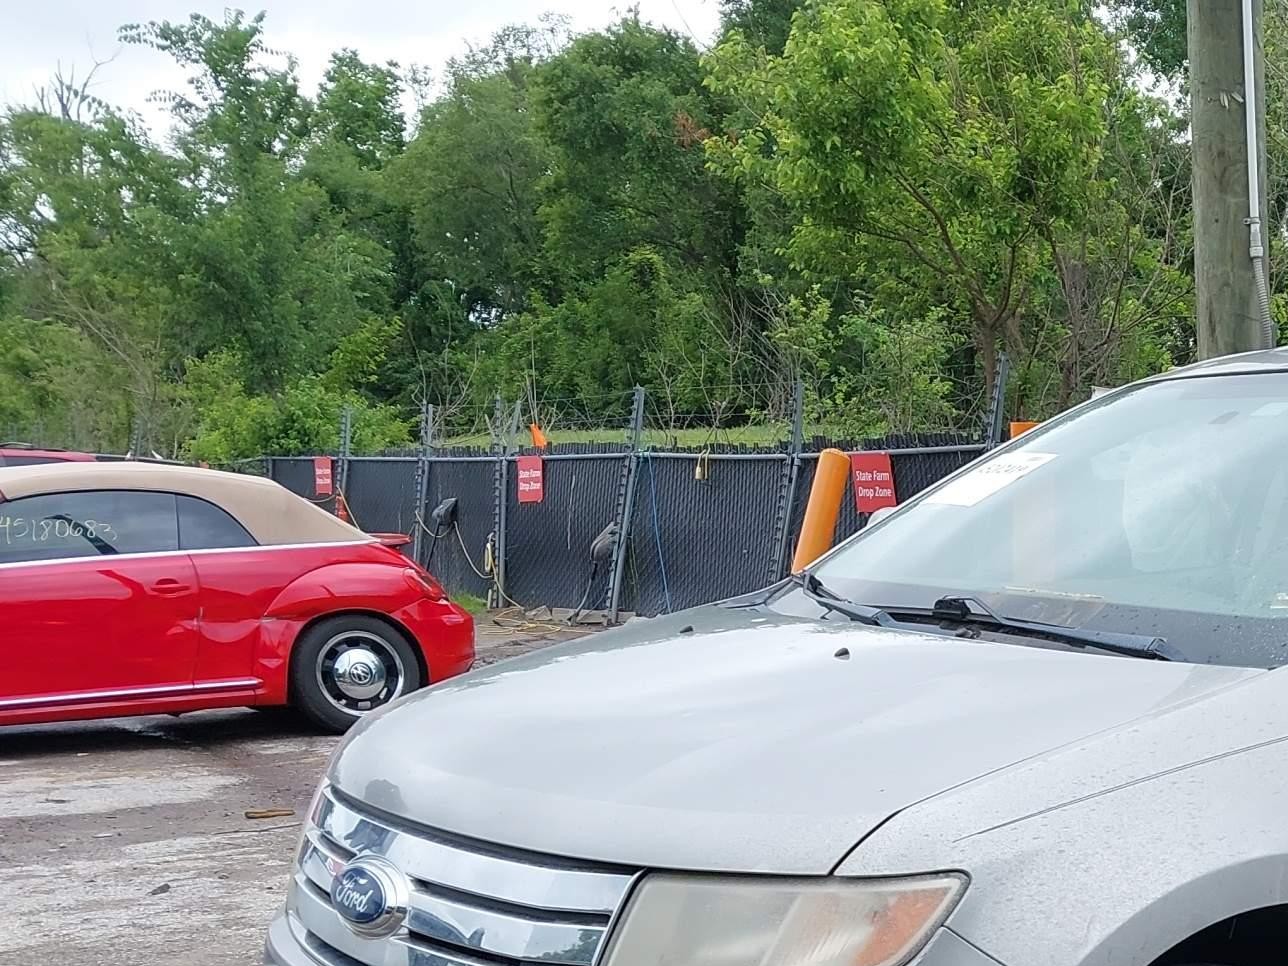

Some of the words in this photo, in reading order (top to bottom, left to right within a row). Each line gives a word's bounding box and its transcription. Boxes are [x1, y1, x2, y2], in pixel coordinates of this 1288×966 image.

[855, 470, 873, 481] State
[873, 470, 890, 481] Farm
[858, 486, 874, 500] Drop
[874, 486, 892, 497] Zone
[335, 871, 374, 913] Ford
